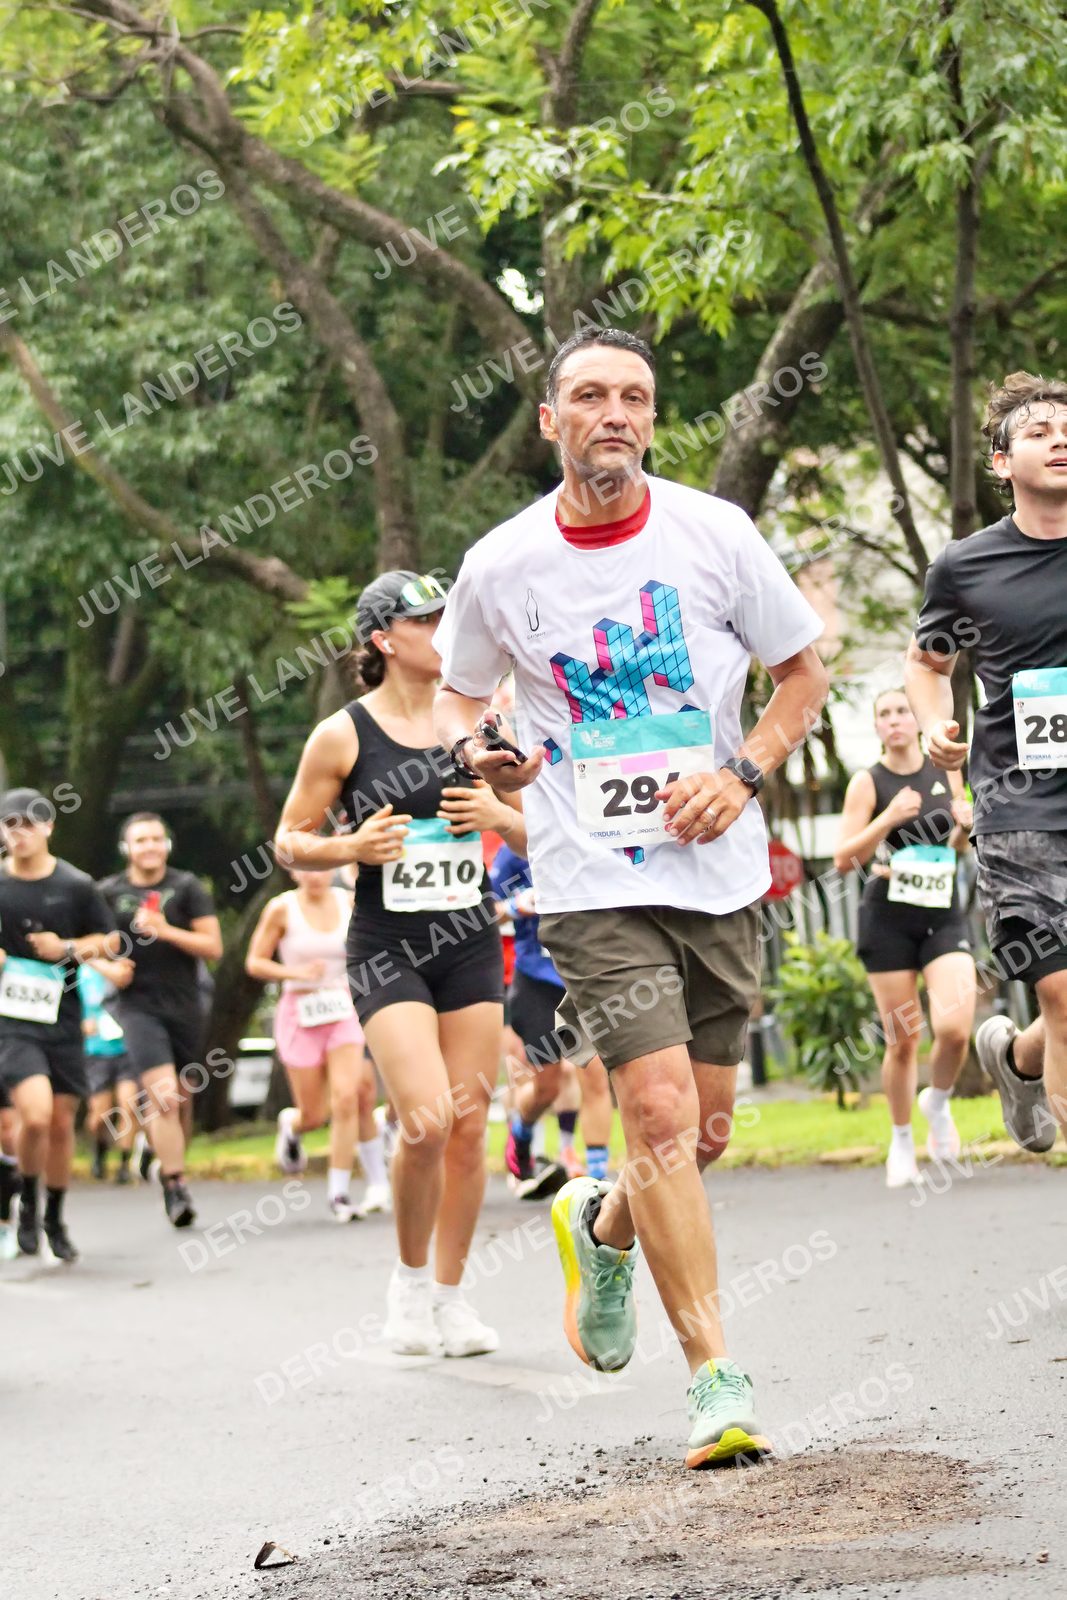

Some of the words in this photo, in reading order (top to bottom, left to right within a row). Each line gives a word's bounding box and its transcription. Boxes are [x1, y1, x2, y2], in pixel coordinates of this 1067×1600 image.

[1024, 714, 1067, 744] 28
[589, 830, 621, 838] PERDURA
[392, 859, 476, 888] 4210
